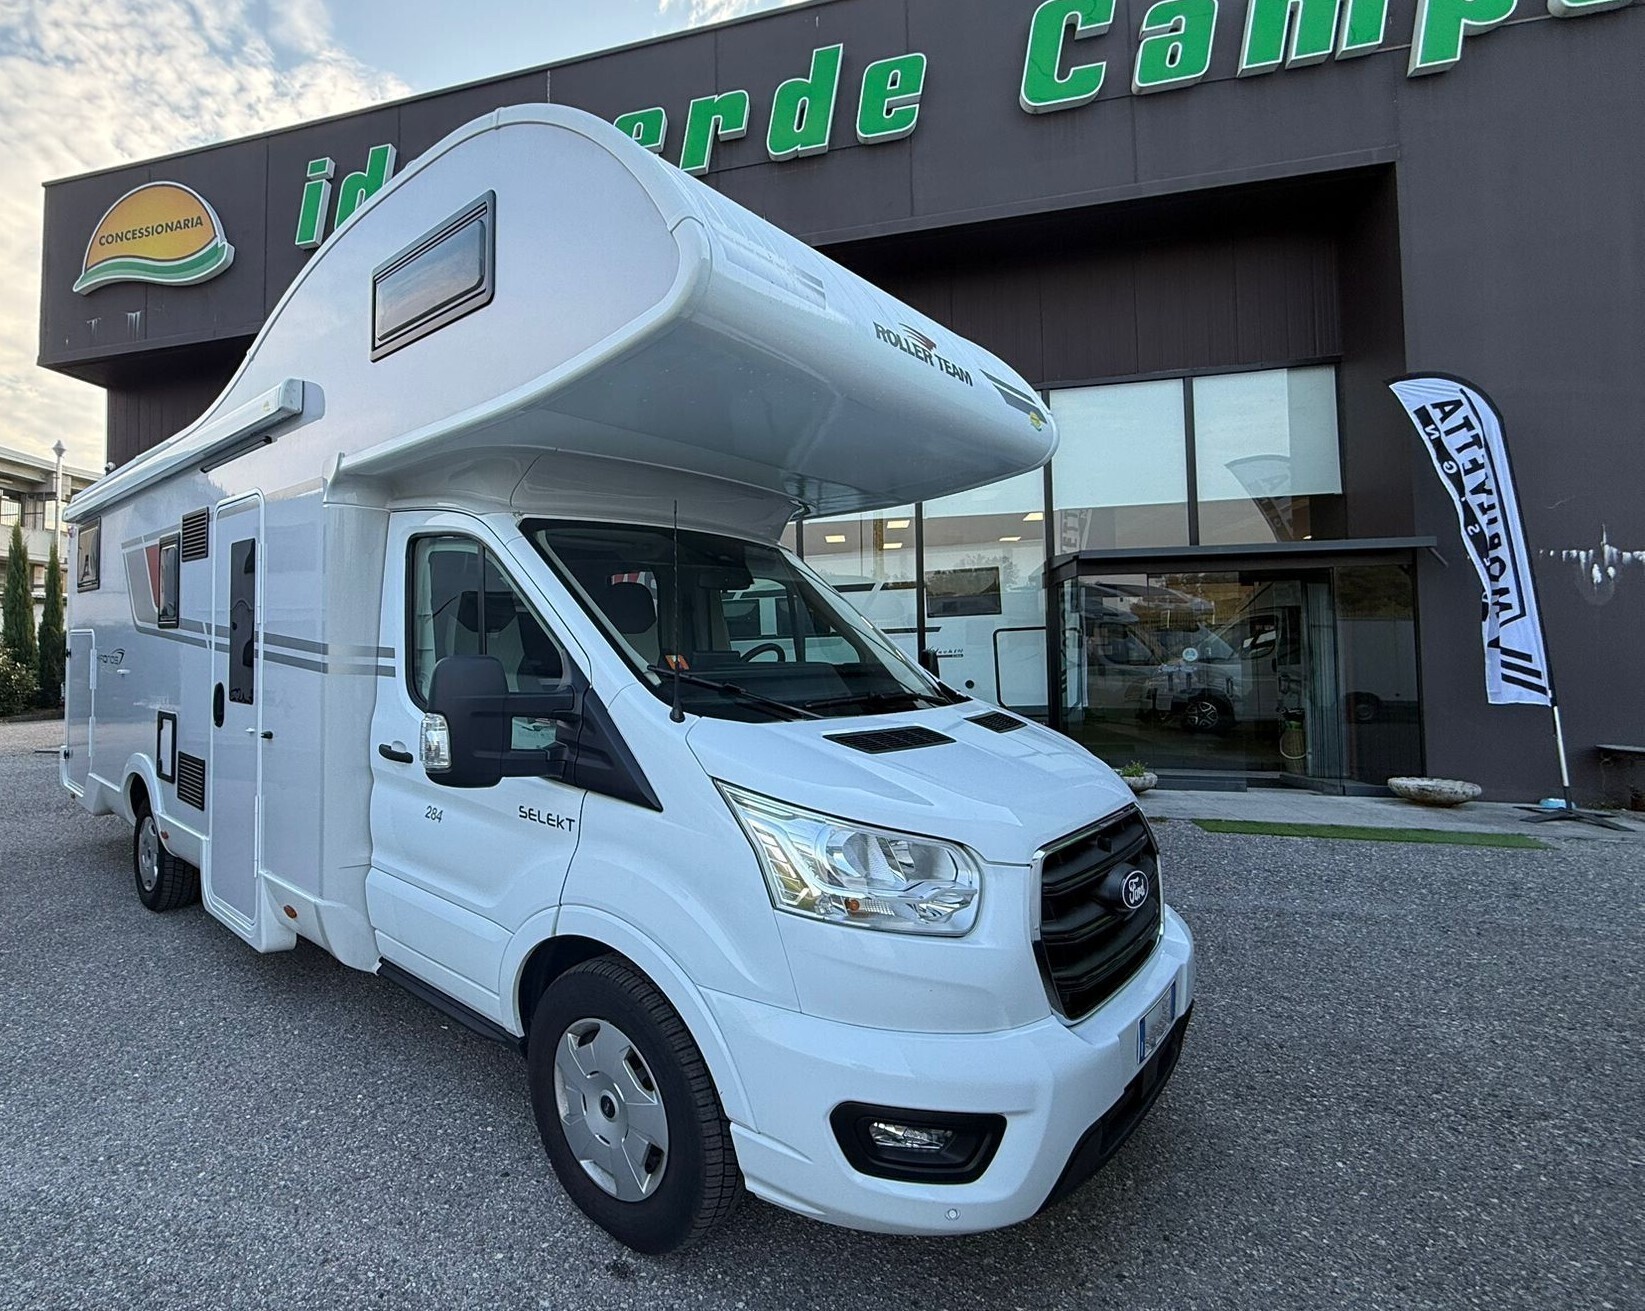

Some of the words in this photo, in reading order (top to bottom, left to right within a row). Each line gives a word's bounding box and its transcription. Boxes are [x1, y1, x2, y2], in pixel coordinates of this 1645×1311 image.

[295, 143, 396, 250] id
[613, 43, 927, 175] erde
[1019, 0, 1632, 113] Camp
[98, 215, 204, 246] CONCESSIONARIA
[872, 320, 935, 367] ROLLER
[934, 353, 973, 387] TEAM
[424, 805, 444, 823] 284
[518, 805, 576, 832] SELEKT
[1128, 876, 1146, 904] Ford
